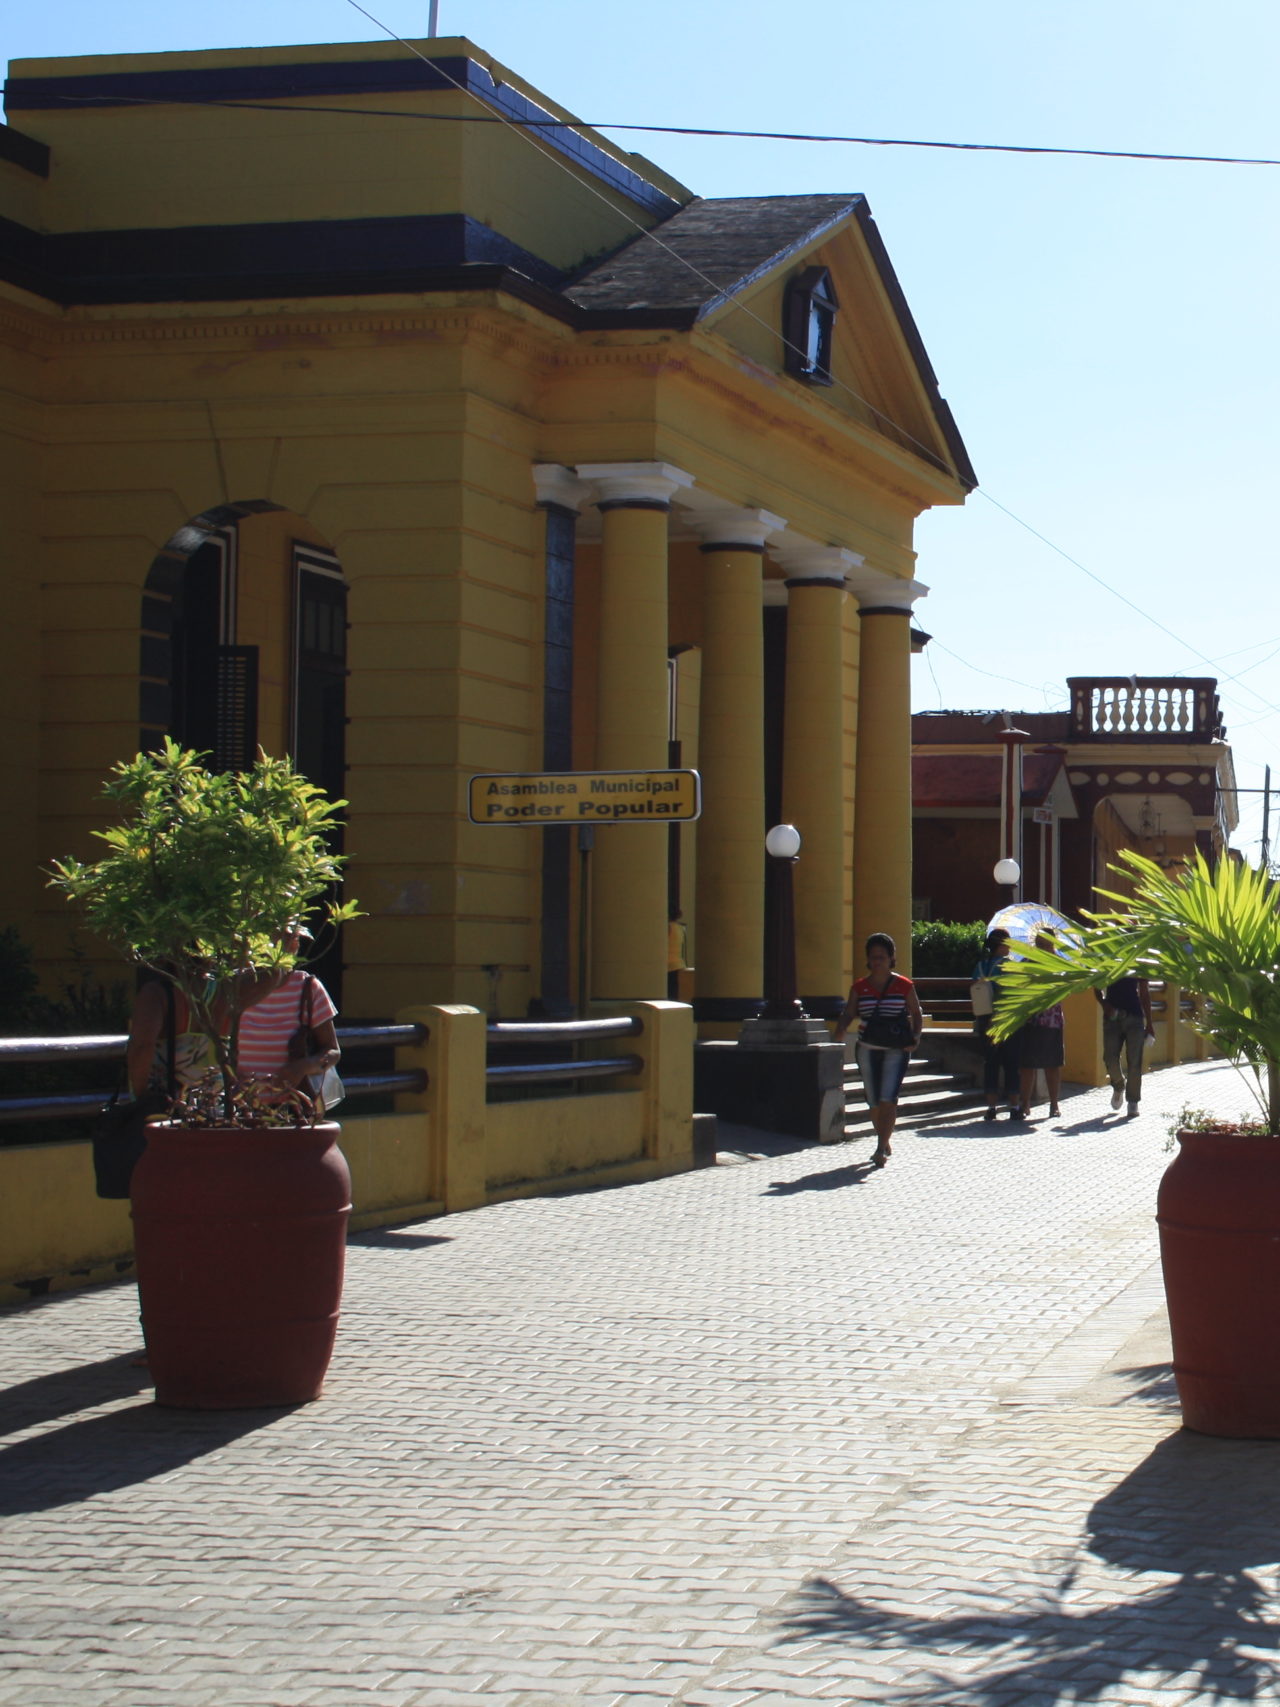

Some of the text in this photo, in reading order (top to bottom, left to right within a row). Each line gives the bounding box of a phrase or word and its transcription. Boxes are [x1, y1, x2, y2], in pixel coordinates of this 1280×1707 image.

[487, 778, 680, 796] Asamblea Municipal
[486, 801, 683, 817] Poder Popular
